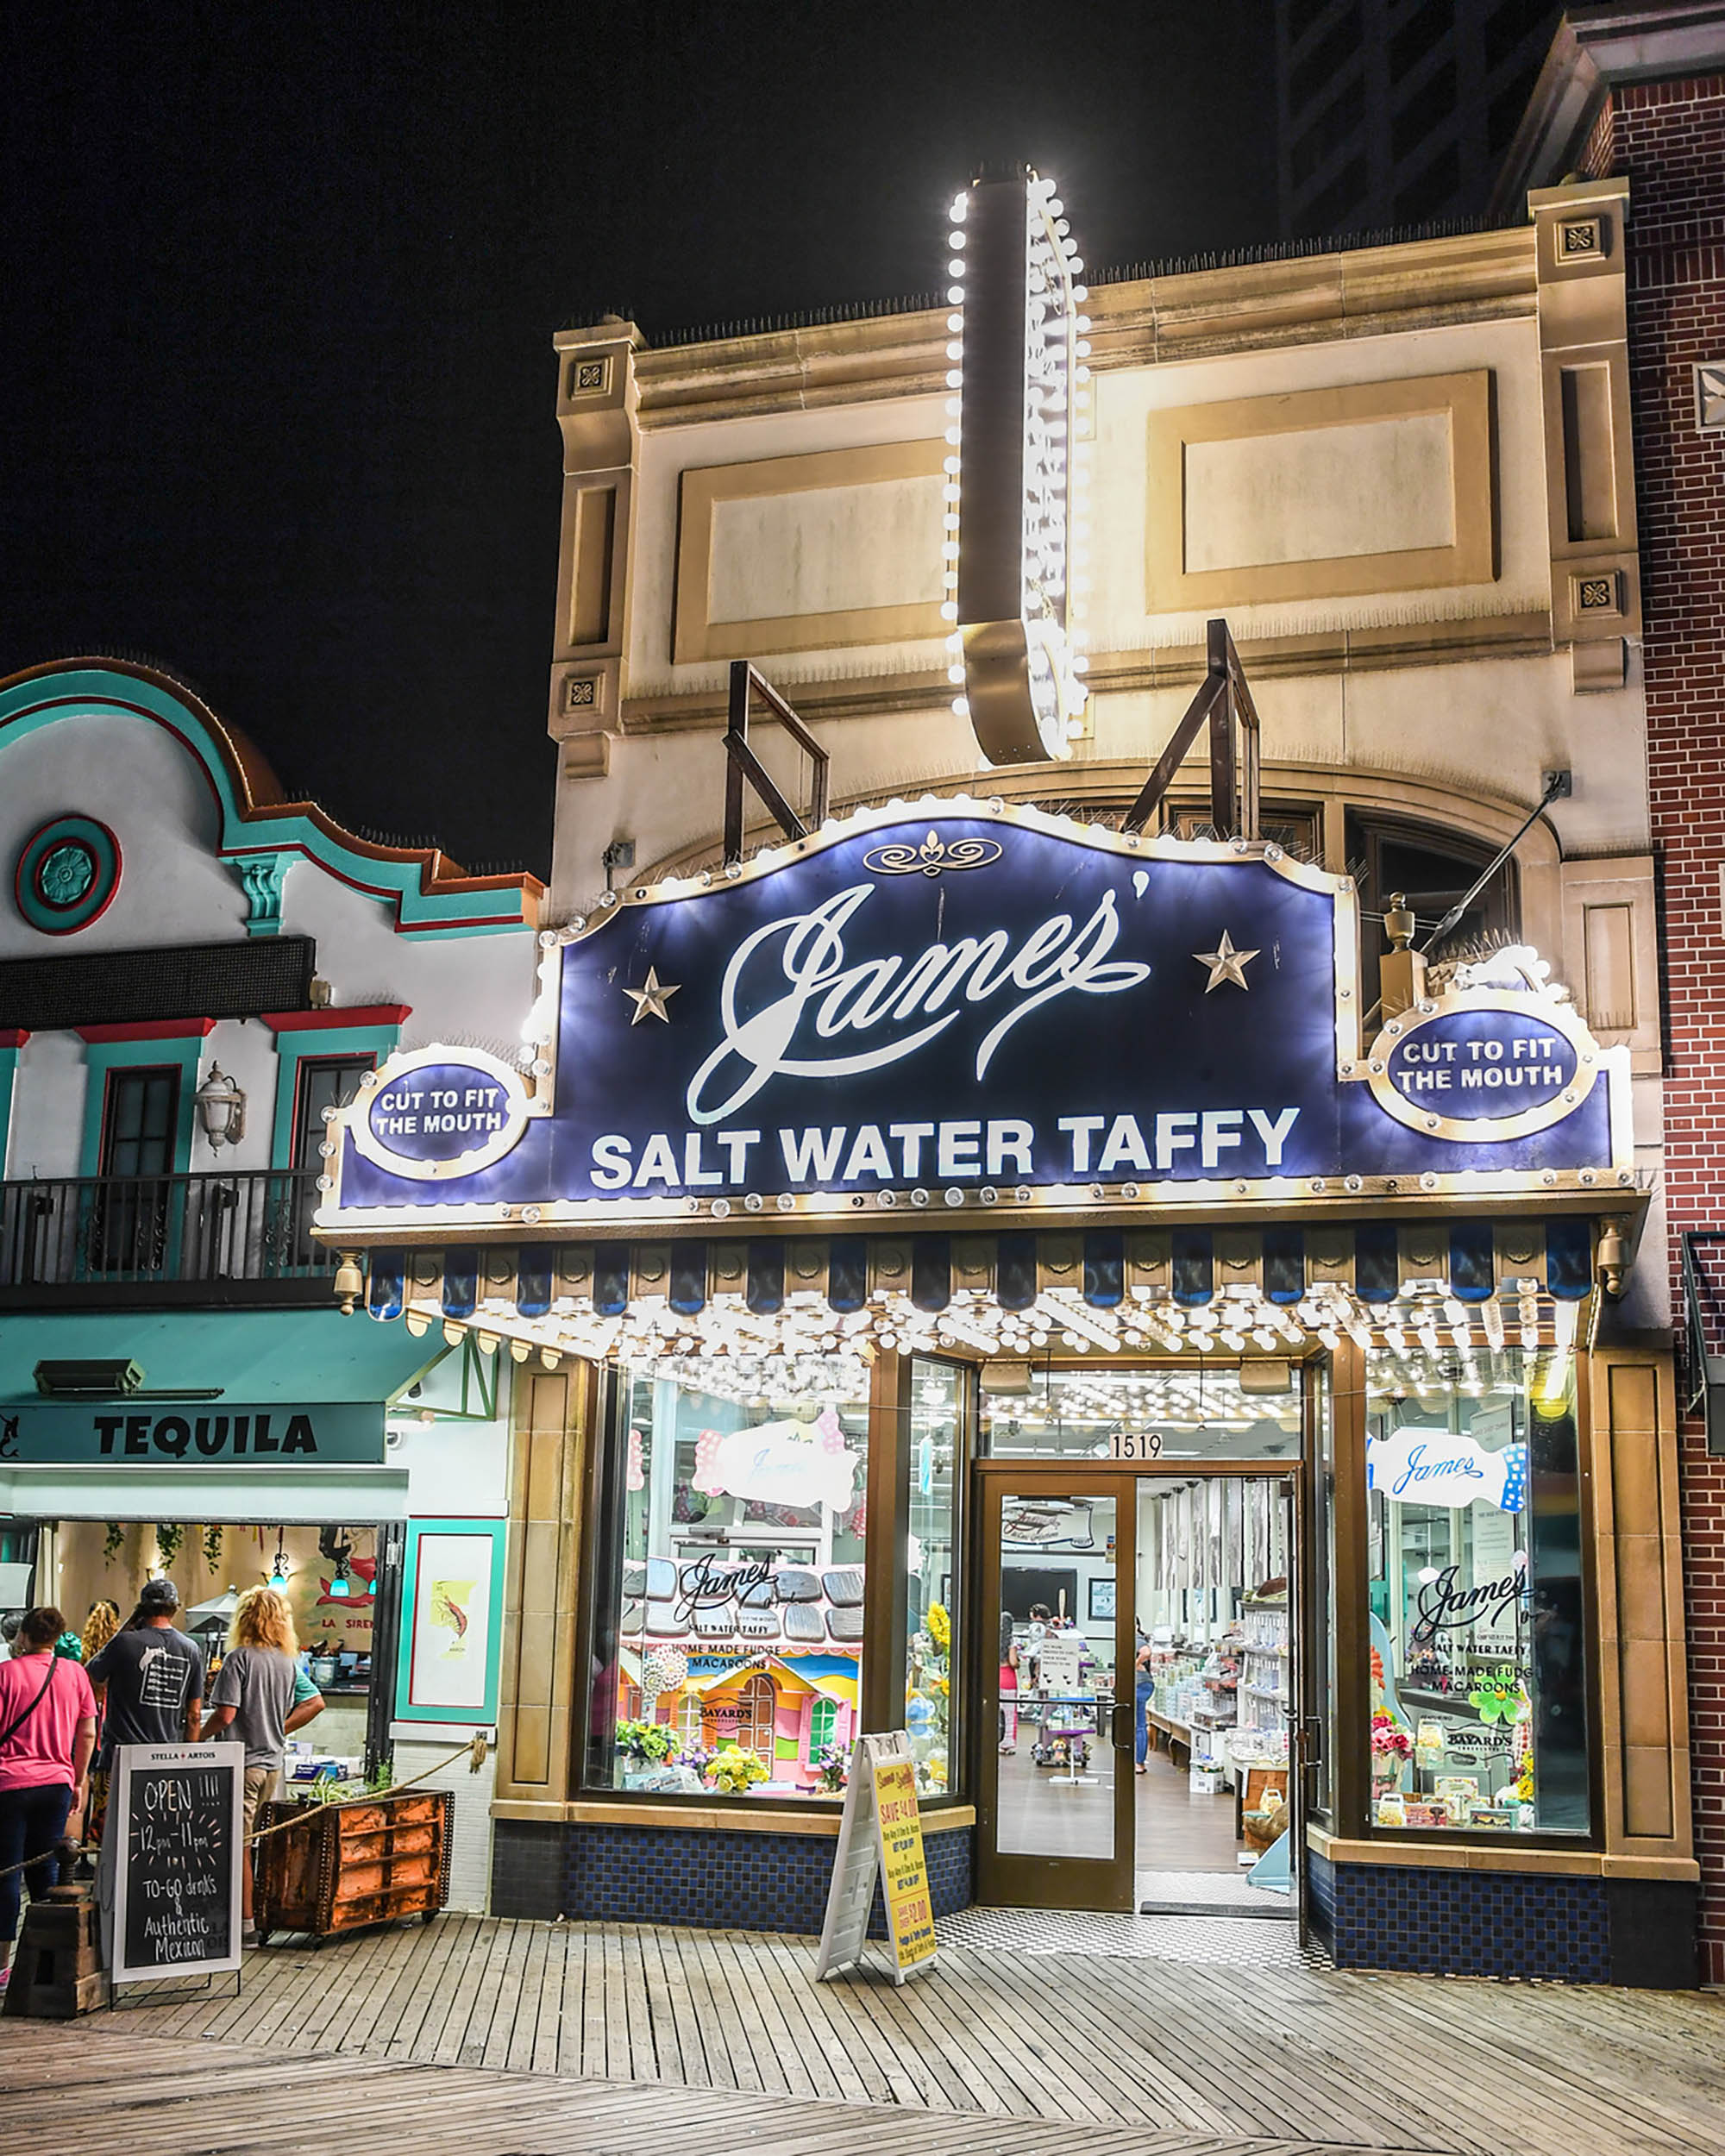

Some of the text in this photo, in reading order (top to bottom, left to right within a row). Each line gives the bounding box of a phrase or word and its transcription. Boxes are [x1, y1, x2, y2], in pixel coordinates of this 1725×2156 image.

[1403, 1037, 1555, 1063] CUT TO FIT
[1396, 1065, 1563, 1093] THE MOUTH
[382, 1087, 499, 1111] CUT TO FIT
[375, 1112, 501, 1136] THE MOUTH
[589, 1107, 1301, 1190] SALT WATER TAFFY
[94, 1413, 318, 1459] TEQUILA
[1113, 1434, 1162, 1458] 1519
[322, 1619, 336, 1628] LA
[742, 1625, 769, 1634] TAFFY
[708, 1644, 740, 1655] MADE
[743, 1645, 781, 1656] FUDGE
[692, 1658, 767, 1670] MACAROONS
[1497, 1667, 1534, 1678] FUDG
[1433, 1682, 1521, 1694] MACAROONS
[1447, 1733, 1513, 1746] BAYARD'S
[144, 1779, 192, 1811] OPEN
[144, 1913, 210, 1939] Authentic
